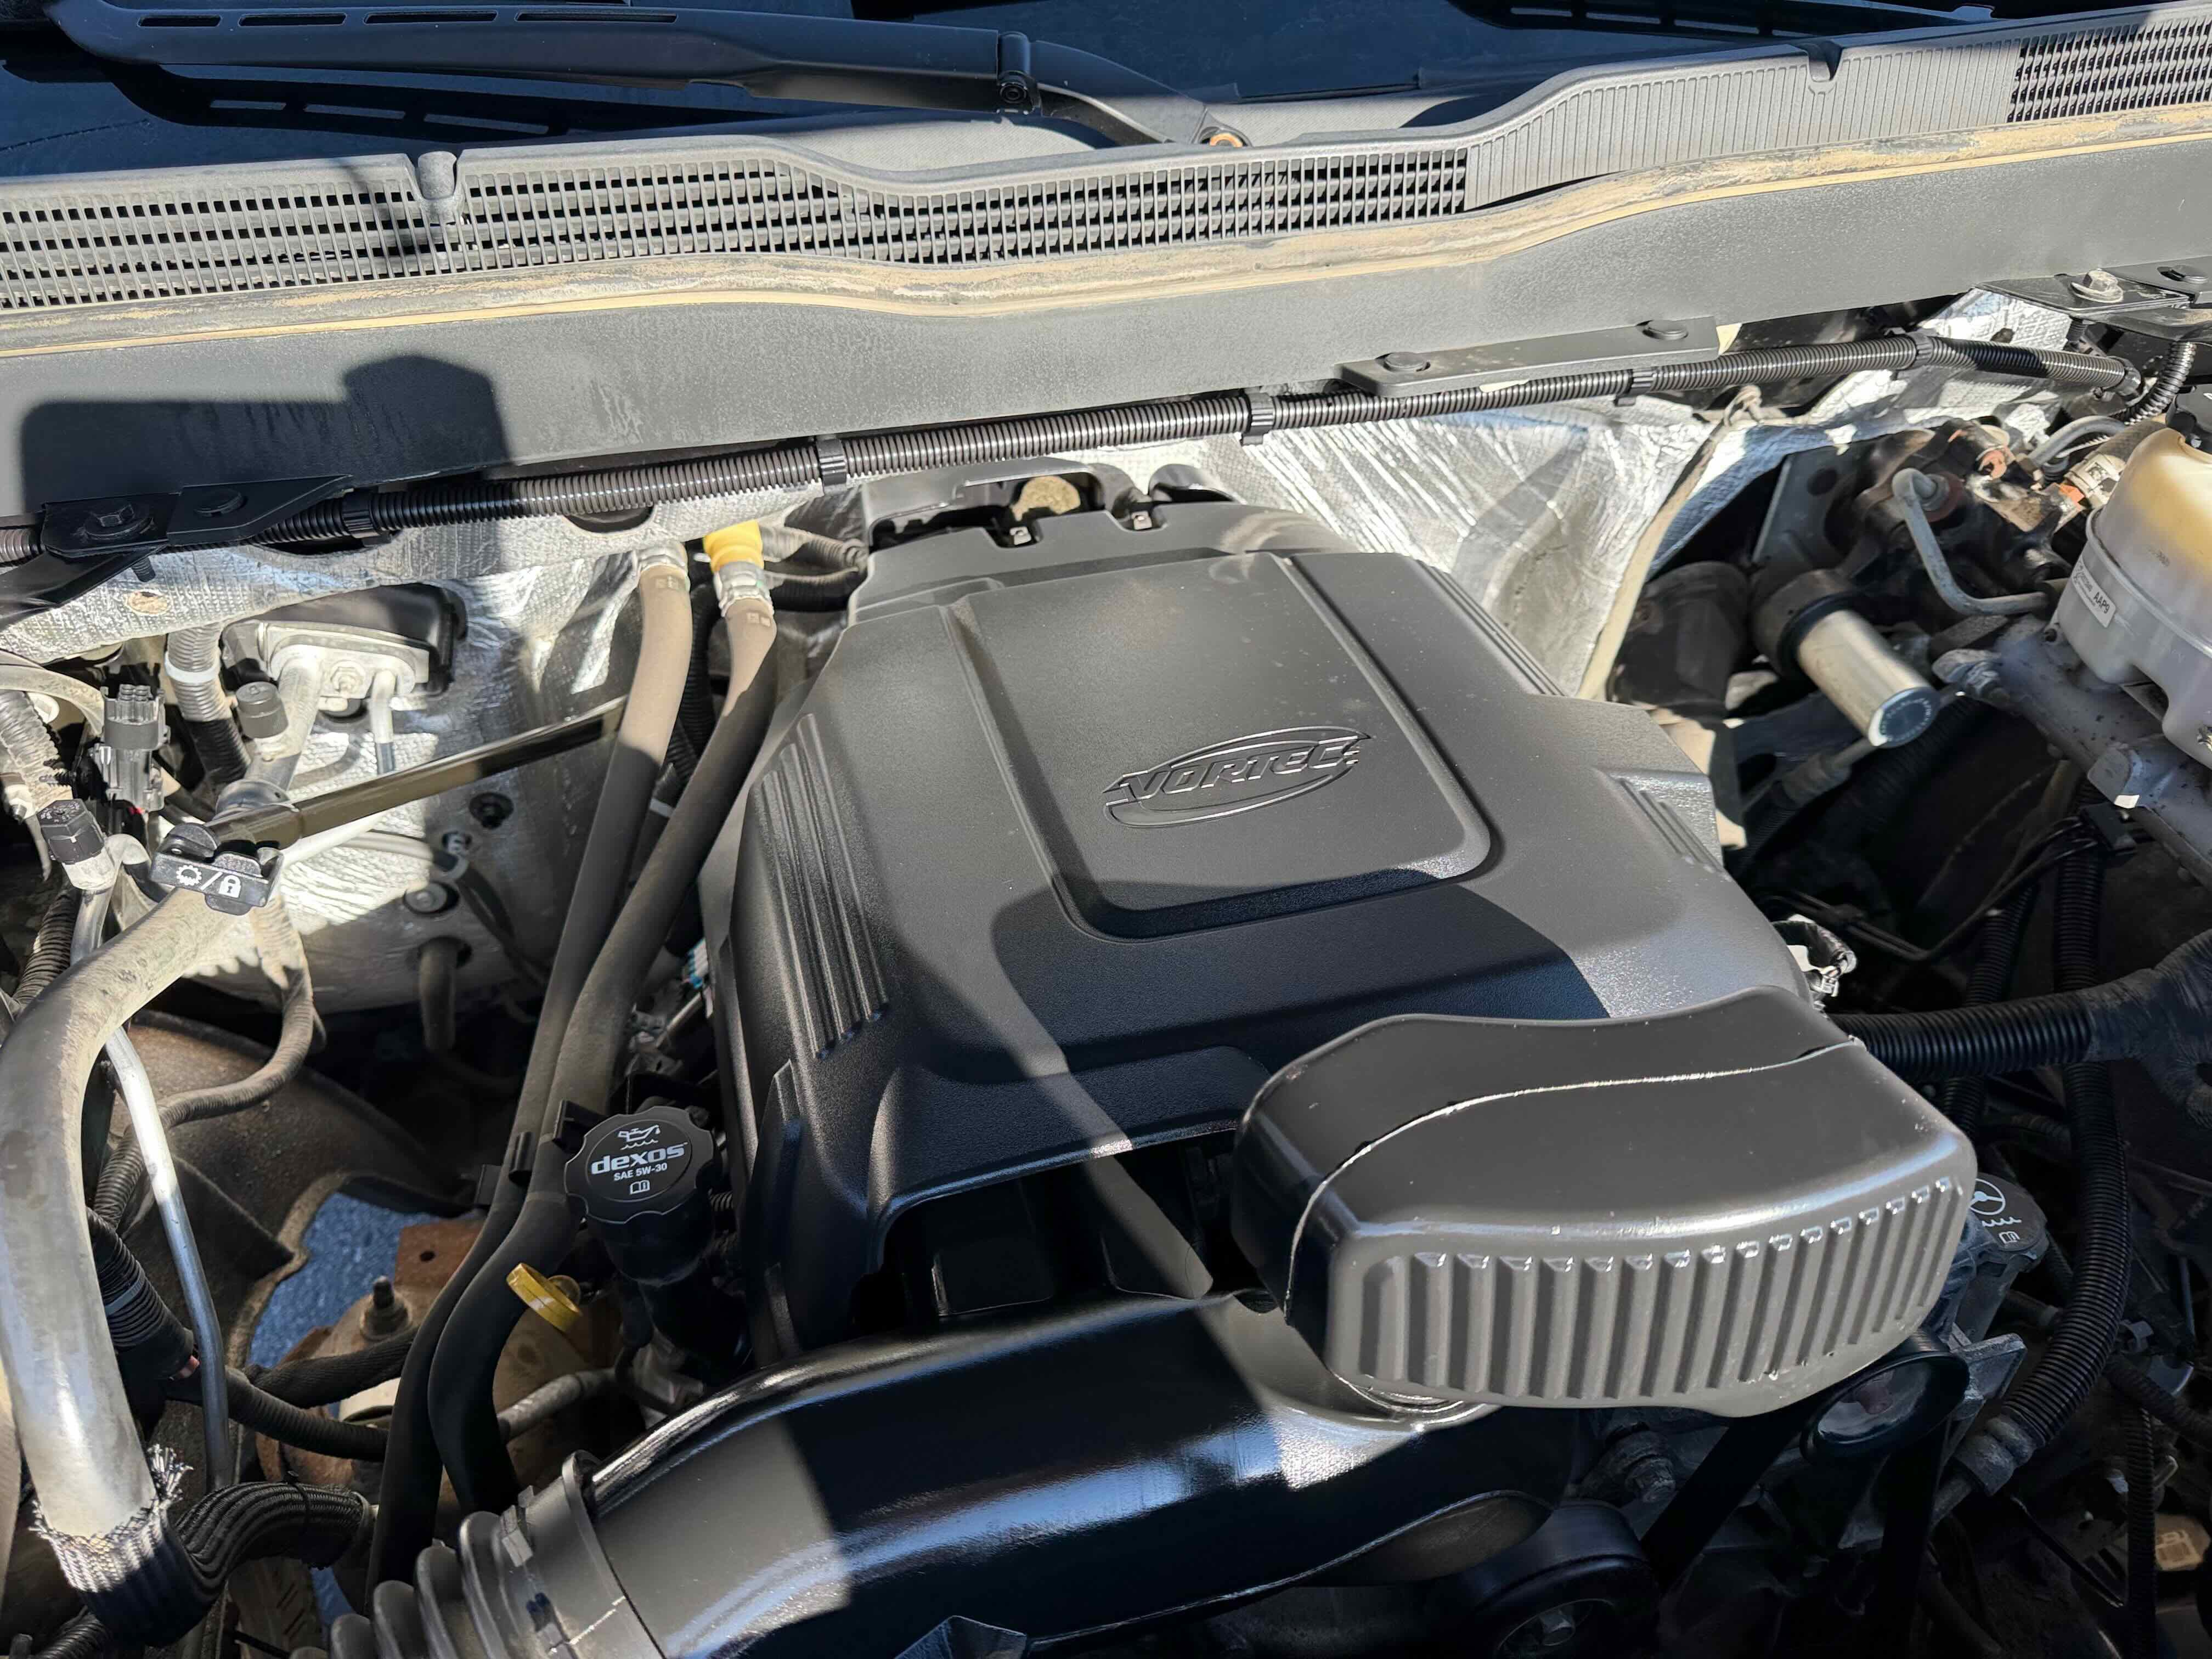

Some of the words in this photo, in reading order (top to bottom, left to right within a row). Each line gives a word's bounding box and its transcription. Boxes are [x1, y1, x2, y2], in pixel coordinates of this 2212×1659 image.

[1104, 735, 1359, 805] VORTEC
[591, 1144, 685, 1175] dexos
[614, 1170, 634, 1181] SAE
[636, 1163, 668, 1176] 5W-30
